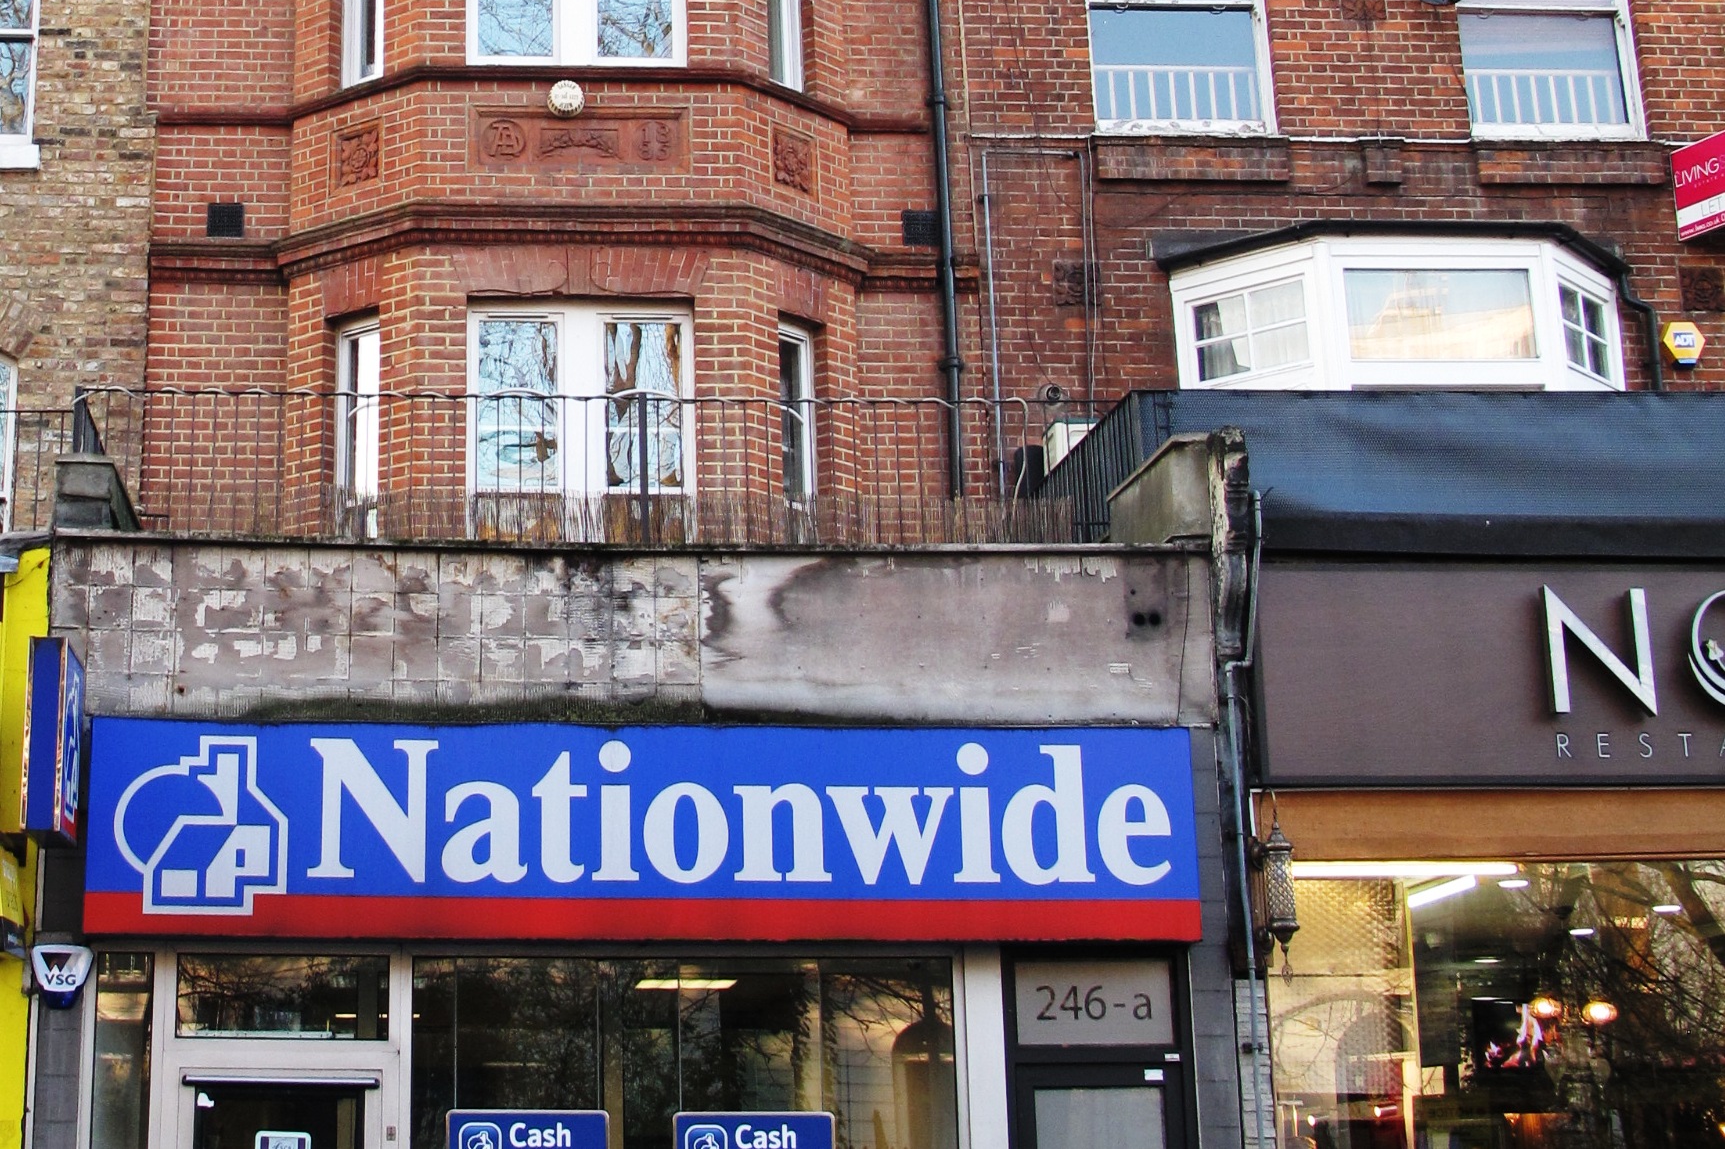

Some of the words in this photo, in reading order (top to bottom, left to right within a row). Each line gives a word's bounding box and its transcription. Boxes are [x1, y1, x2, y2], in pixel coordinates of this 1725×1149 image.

[1701, 195, 1723, 218] LET
[1674, 334, 1694, 346] ADT
[1556, 732, 1725, 759] REST
[306, 737, 1172, 886] Nationwide
[44, 973, 77, 987] VSG
[1035, 985, 1153, 1021] 246-a
[509, 1121, 572, 1148] Cash
[734, 1123, 797, 1149] Cash
